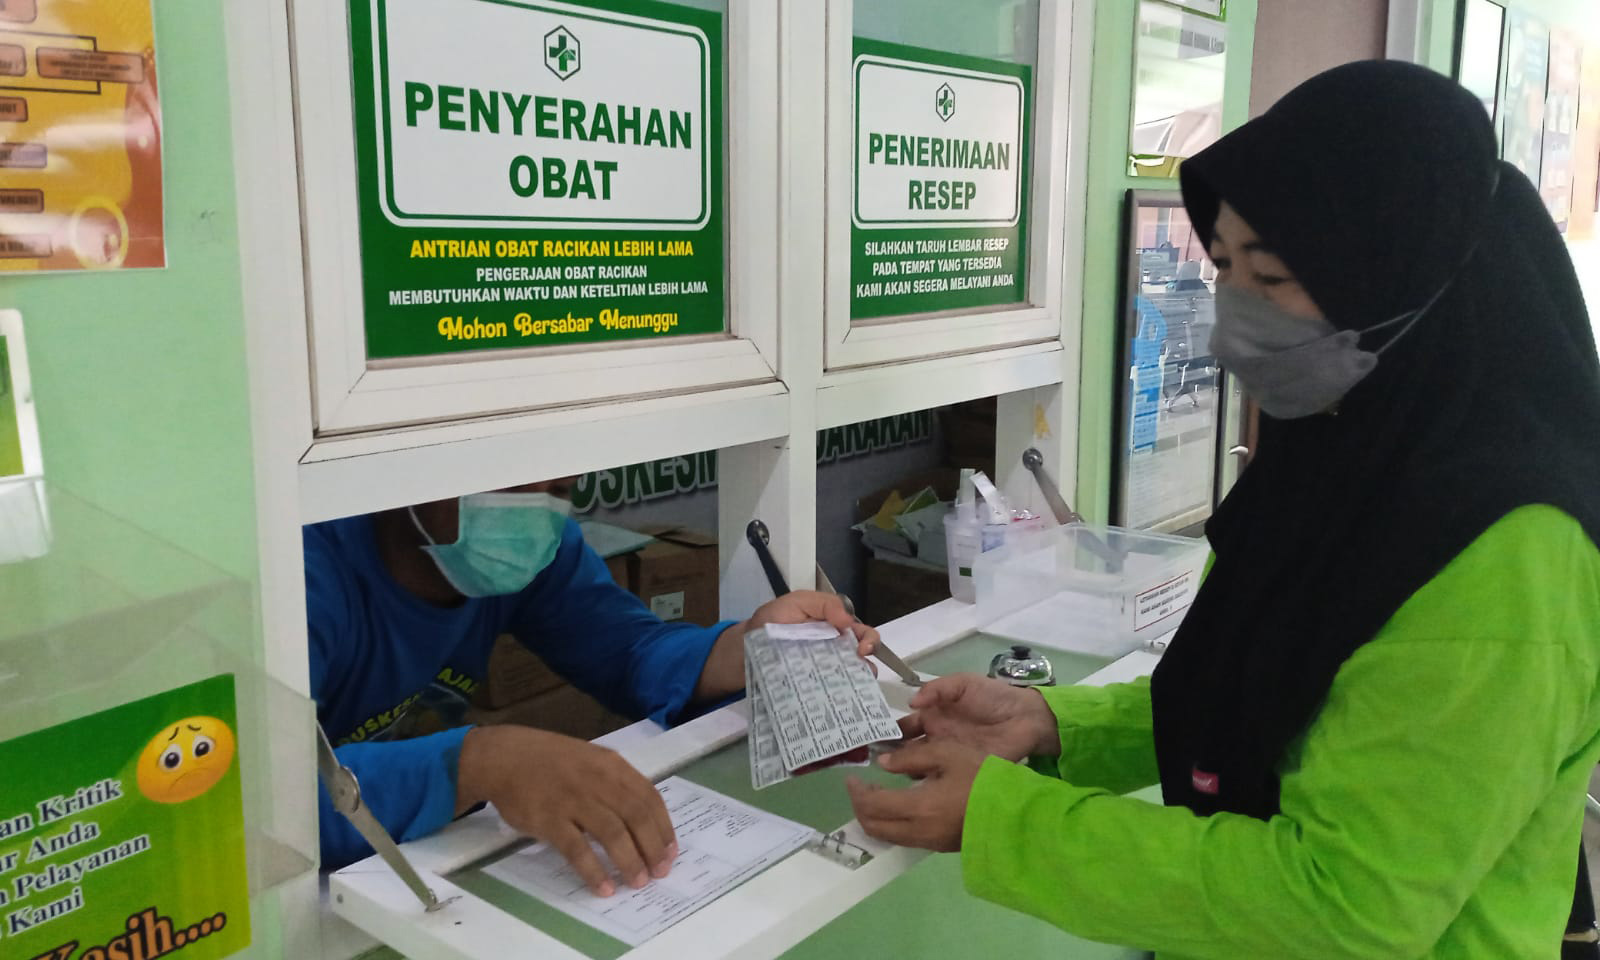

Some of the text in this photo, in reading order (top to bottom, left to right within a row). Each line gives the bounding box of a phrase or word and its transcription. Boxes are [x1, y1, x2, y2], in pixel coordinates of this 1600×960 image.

[404, 80, 692, 149] PENYERAHAN
[869, 133, 1010, 170] PENERIMAAN
[509, 155, 618, 200] OBAT
[908, 180, 977, 210] RESEP
[410, 240, 694, 258] ANTRIAN OBAT RACIKAN LEBIH LAMA
[865, 238, 1009, 256] SILAHKAN TARUH LEMBAR RESEP
[476, 265, 647, 282] PENGERJAAN OBAT RACIKAN
[873, 257, 1002, 276] PADA TEMPAT YANG TERSEDIA
[389, 281, 708, 306] MEMBUTUHKAN WAKTU DAN KETELITIAN LEBIH LAMA
[857, 274, 1014, 298] KAMI AKAN SEGERA MELAYANI ANDA
[438, 309, 678, 340] Mohon Bersabar Menunggu
[39, 780, 121, 823] Kritik
[28, 823, 99, 861] Anda
[15, 836, 149, 898] Pelayanan
[8, 888, 83, 934] Kami
